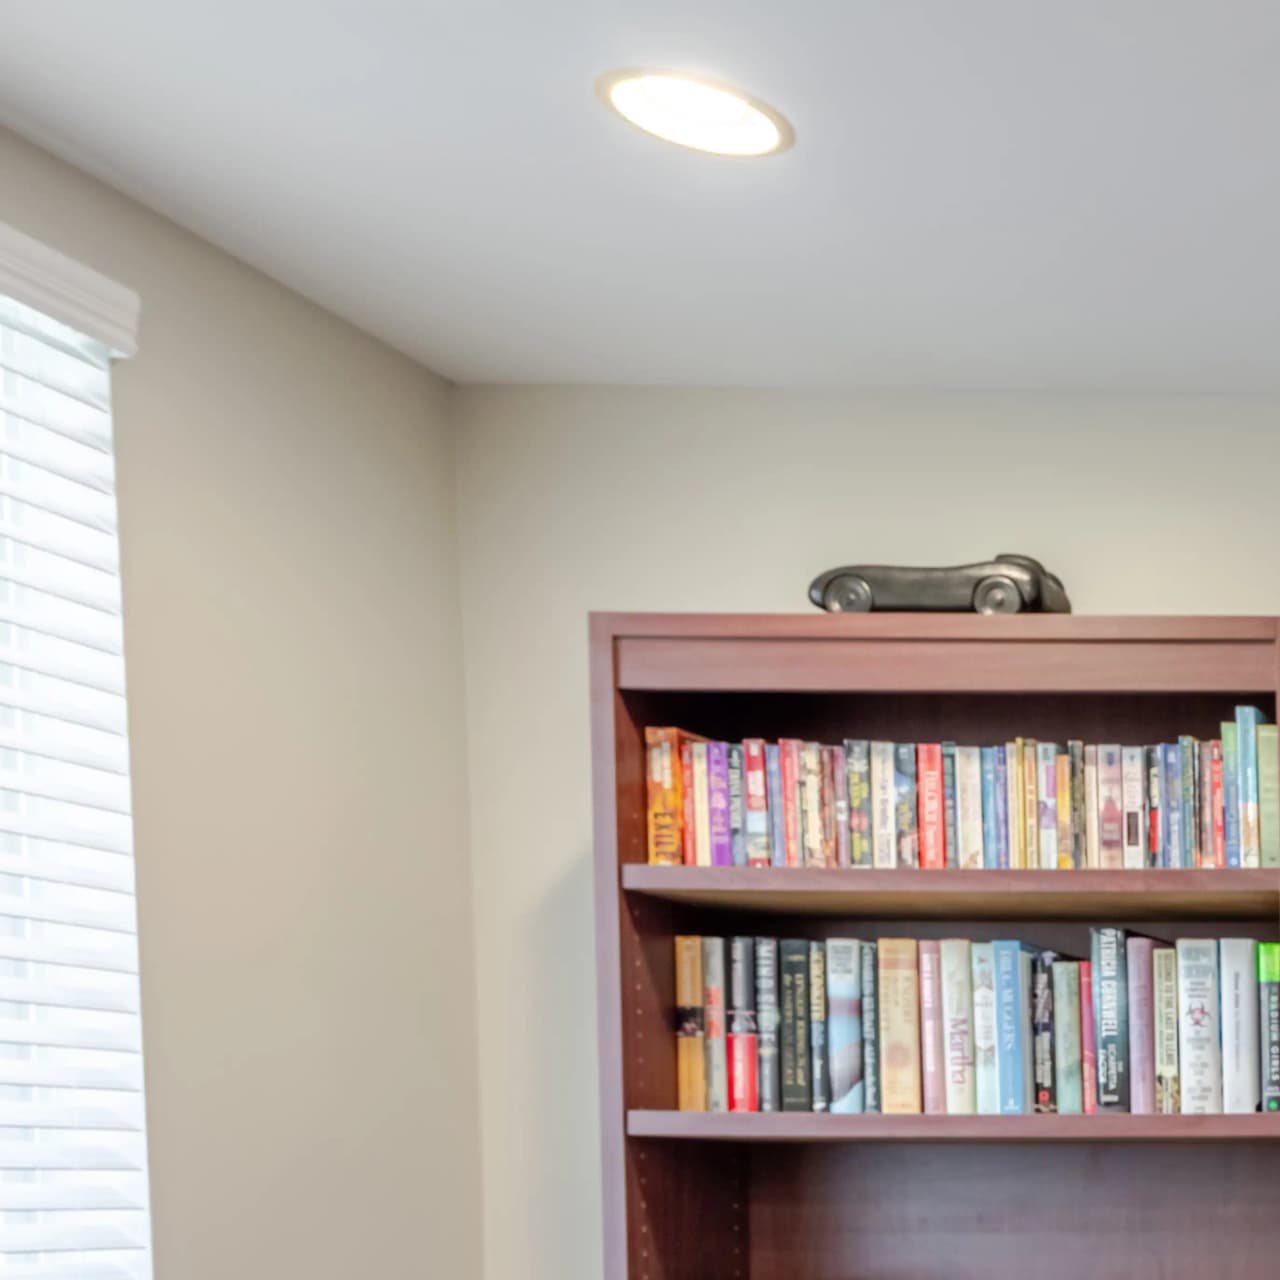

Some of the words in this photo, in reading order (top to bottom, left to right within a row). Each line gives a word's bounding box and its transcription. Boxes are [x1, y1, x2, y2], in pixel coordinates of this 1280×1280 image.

[1101, 928, 1118, 977] PATRICIA
[1101, 980, 1118, 1038] CORNWELL
[1270, 995, 1280, 1041] RADIUM
[950, 1017, 974, 1085] Martha
[1270, 1045, 1280, 1081] GIRLS
